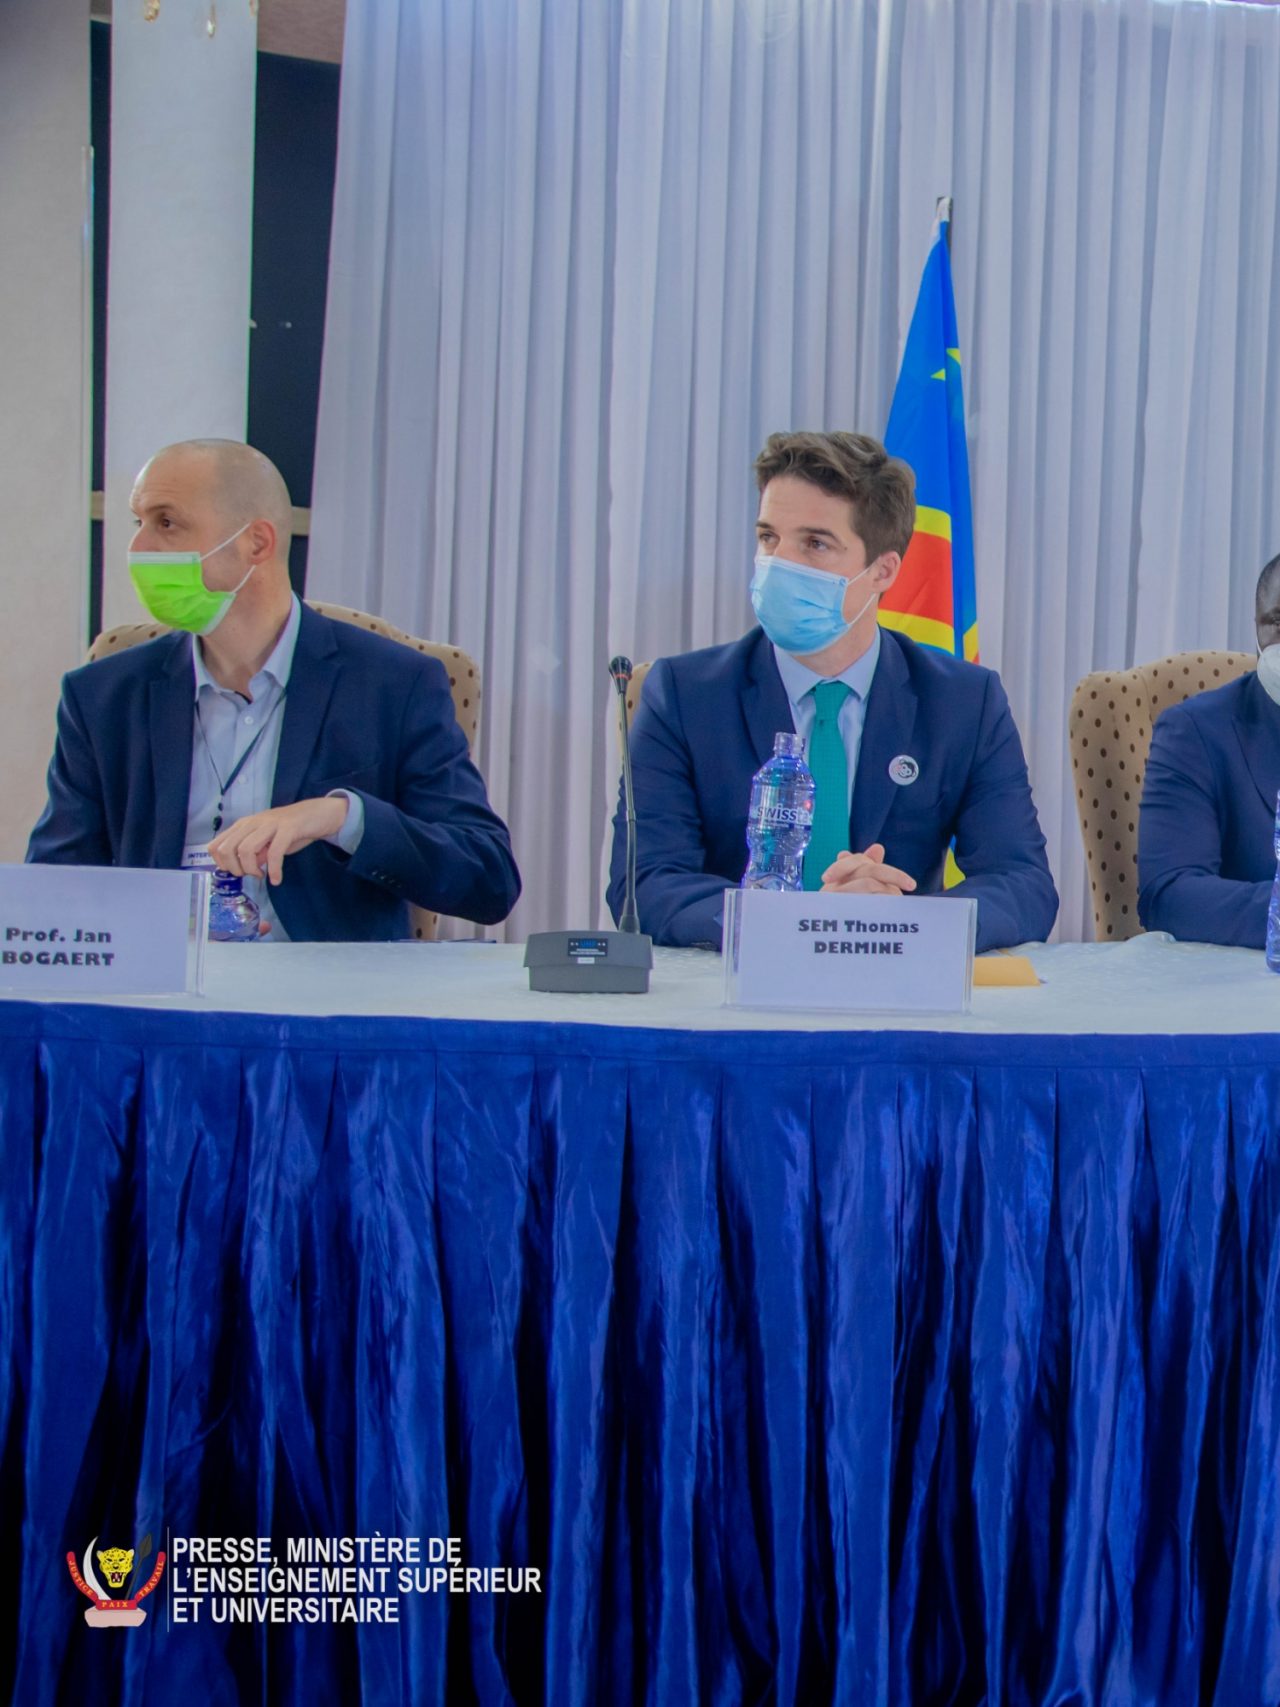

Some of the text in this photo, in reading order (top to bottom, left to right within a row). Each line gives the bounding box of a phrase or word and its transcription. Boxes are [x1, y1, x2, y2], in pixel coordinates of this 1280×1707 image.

[798, 919, 919, 933] SEM Thomas
[5, 927, 112, 943] Prof. Jan
[814, 941, 903, 954] DERMINE
[2, 951, 115, 966] BOGAERT
